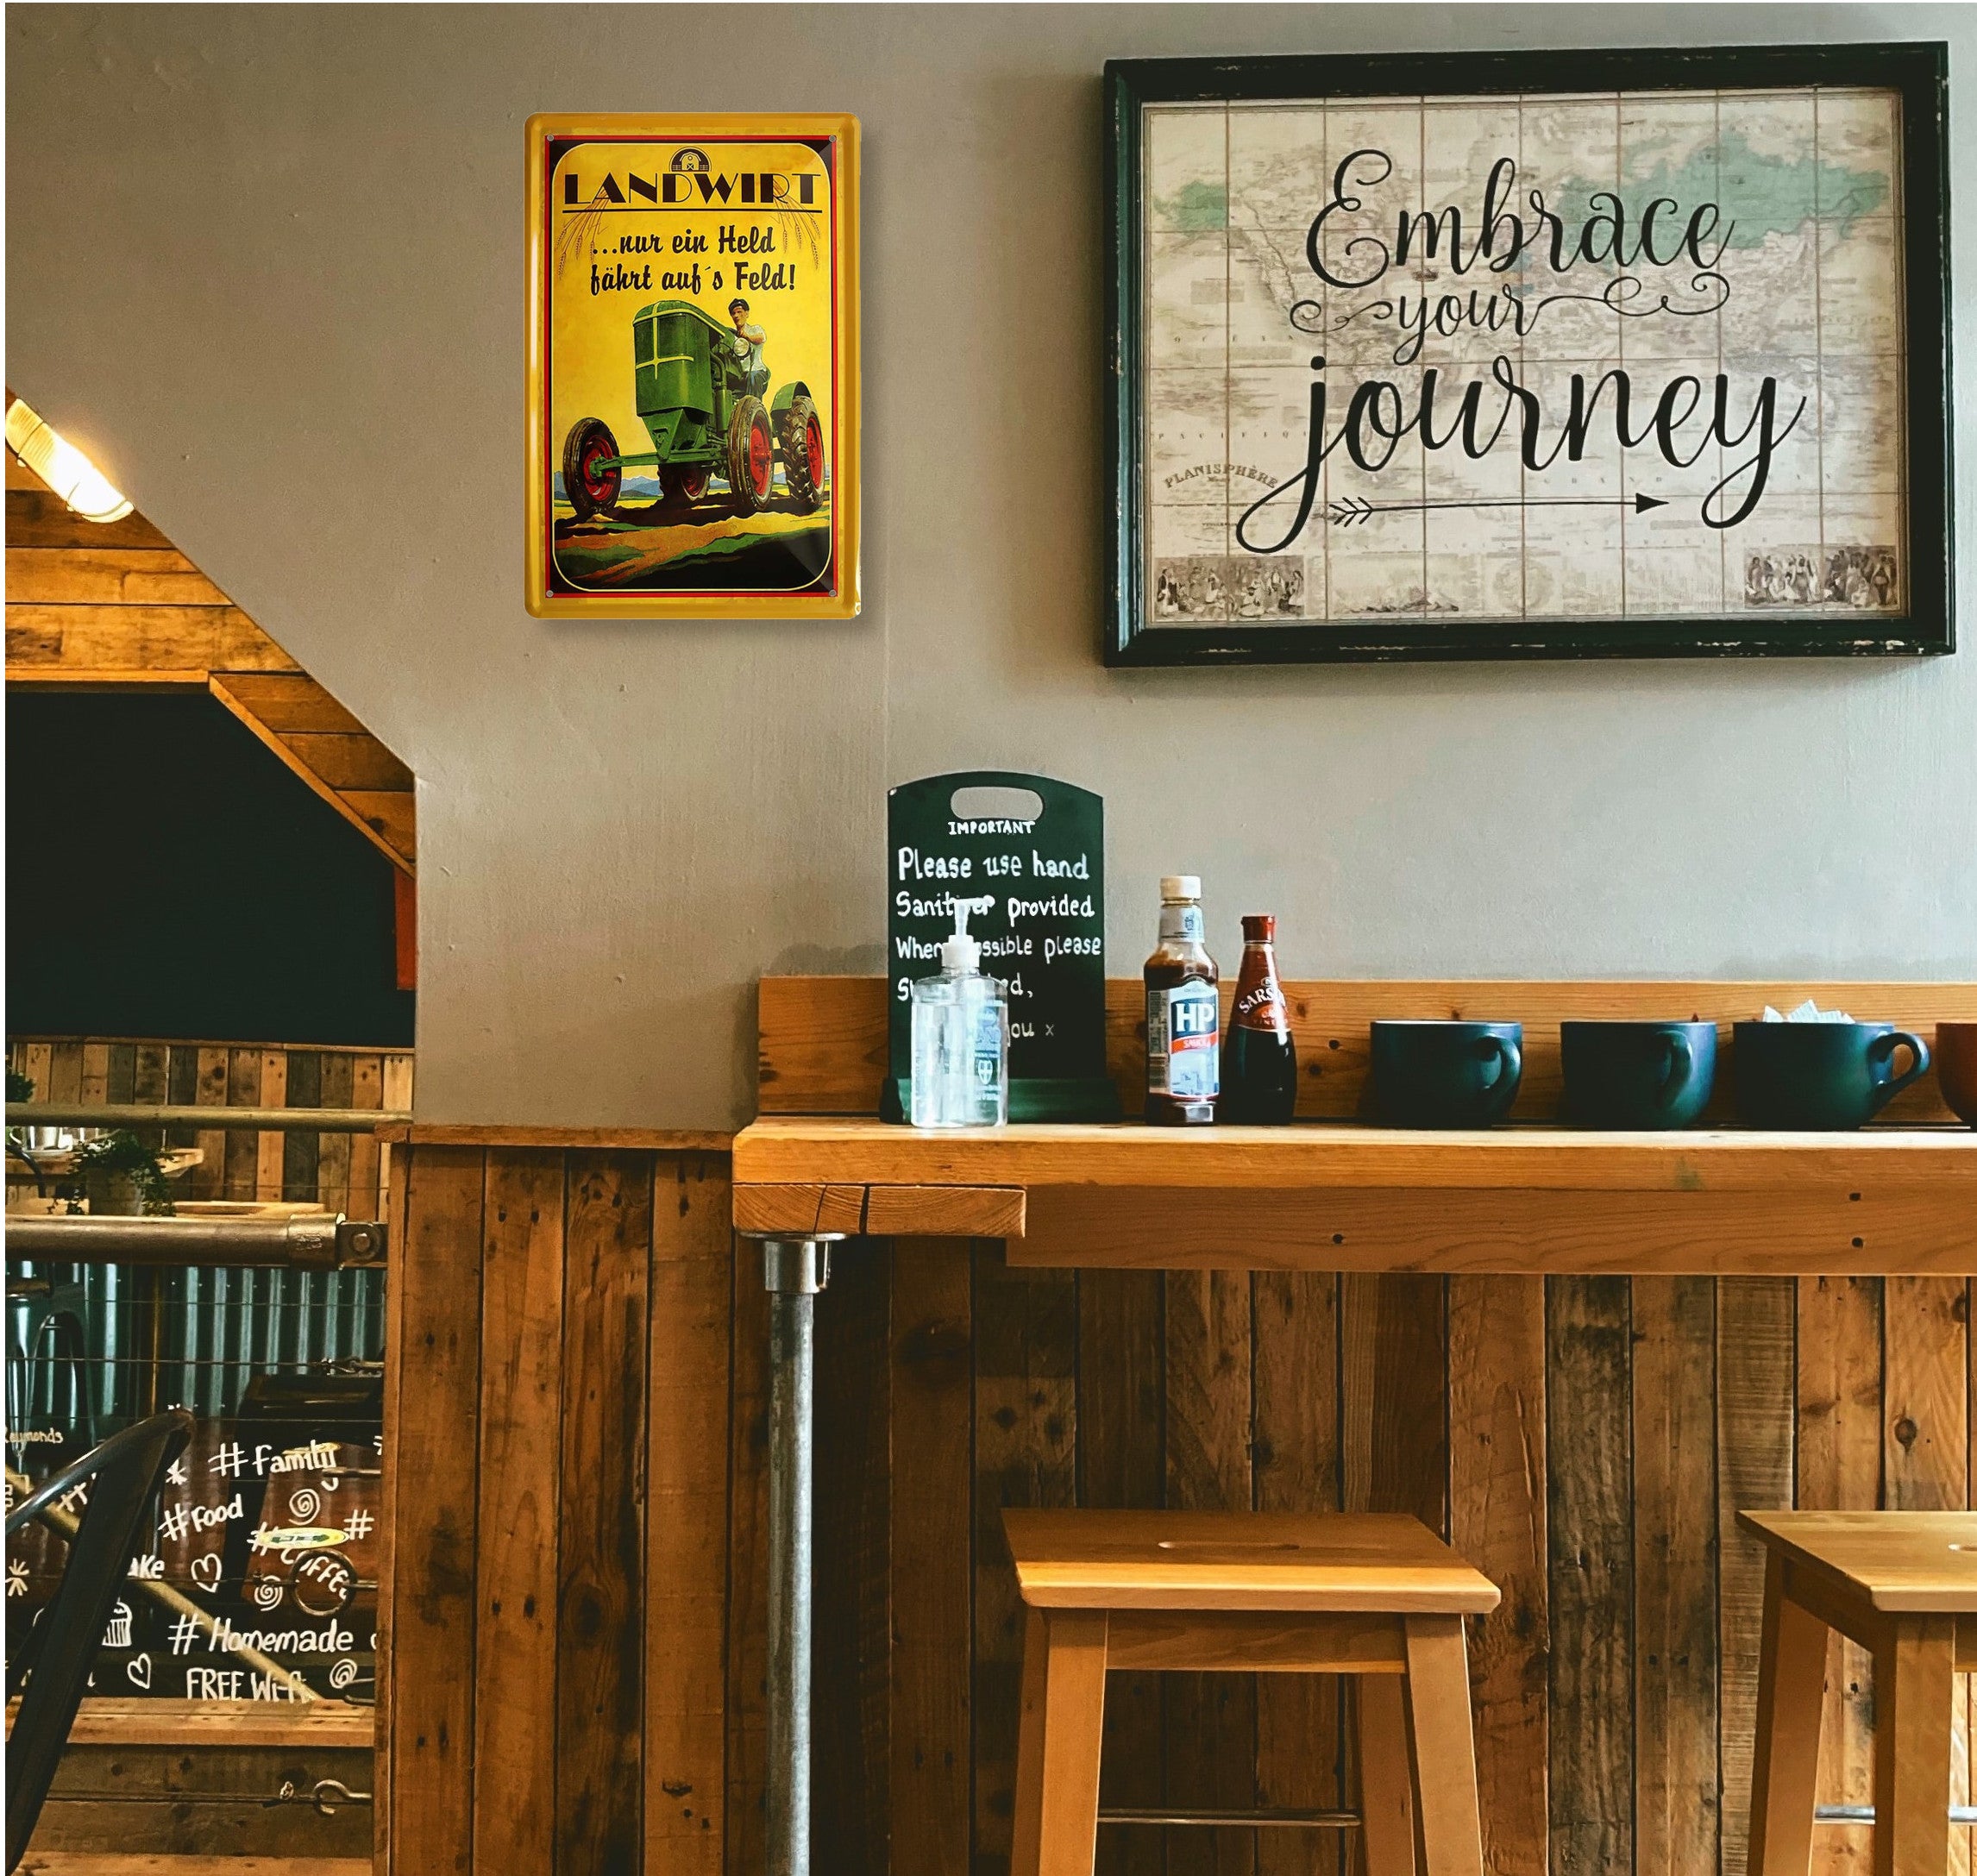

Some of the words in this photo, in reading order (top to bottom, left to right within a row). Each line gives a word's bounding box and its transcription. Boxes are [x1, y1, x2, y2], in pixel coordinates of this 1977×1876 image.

[563, 173, 822, 205] LANDWIRT
[1307, 149, 1735, 289] Embrace
[672, 228, 709, 254] ein
[718, 224, 776, 254] Held
[590, 263, 653, 296] fährt
[734, 261, 795, 291] Feld!
[1236, 354, 1807, 554] journey
[1165, 464, 1278, 488] PLANISPHÈRE
[948, 820, 1036, 836] IMPORTANT
[898, 846, 972, 881] Please
[982, 853, 1023, 877] use
[1032, 849, 1090, 881] hand
[1007, 893, 1095, 927] provided
[1044, 935, 1102, 964] please
[1176, 1002, 1215, 1032] HP
[185, 1667, 245, 1701] FREE
